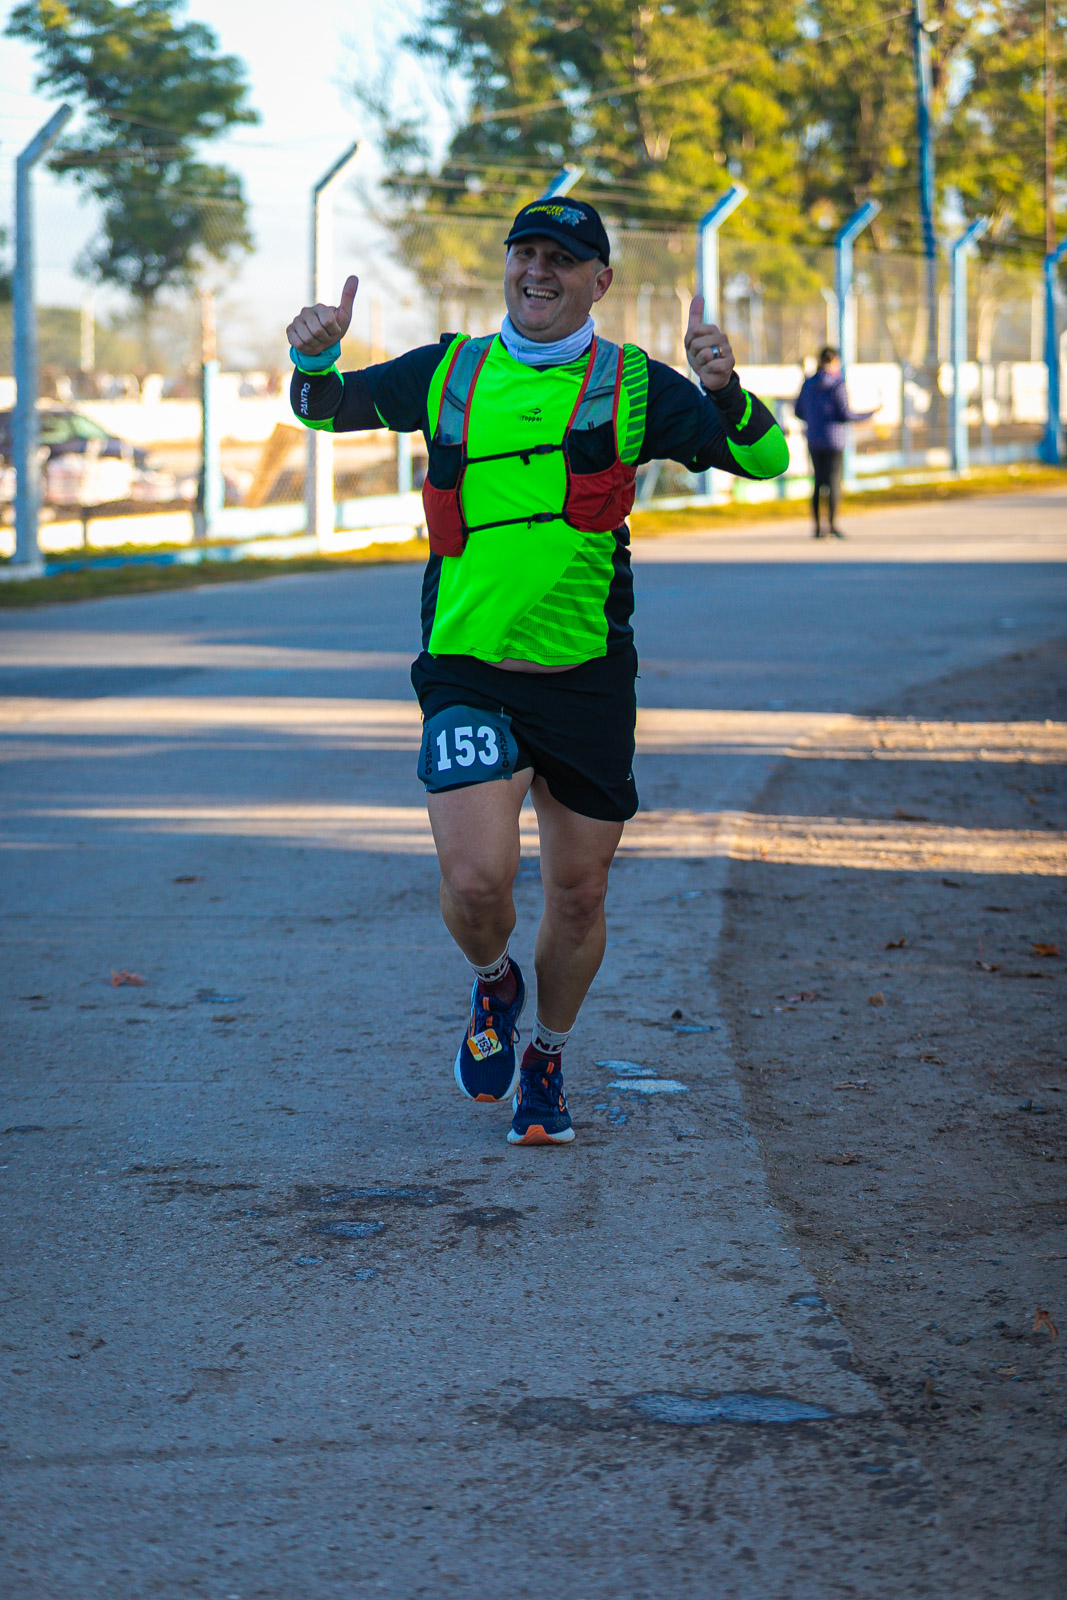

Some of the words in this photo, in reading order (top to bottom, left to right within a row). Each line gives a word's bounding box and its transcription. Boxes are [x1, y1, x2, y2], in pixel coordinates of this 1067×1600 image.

[300, 382, 311, 416] PANTRO
[520, 415, 543, 423] Topper
[436, 725, 499, 772] 153
[478, 1036, 492, 1053] 153
